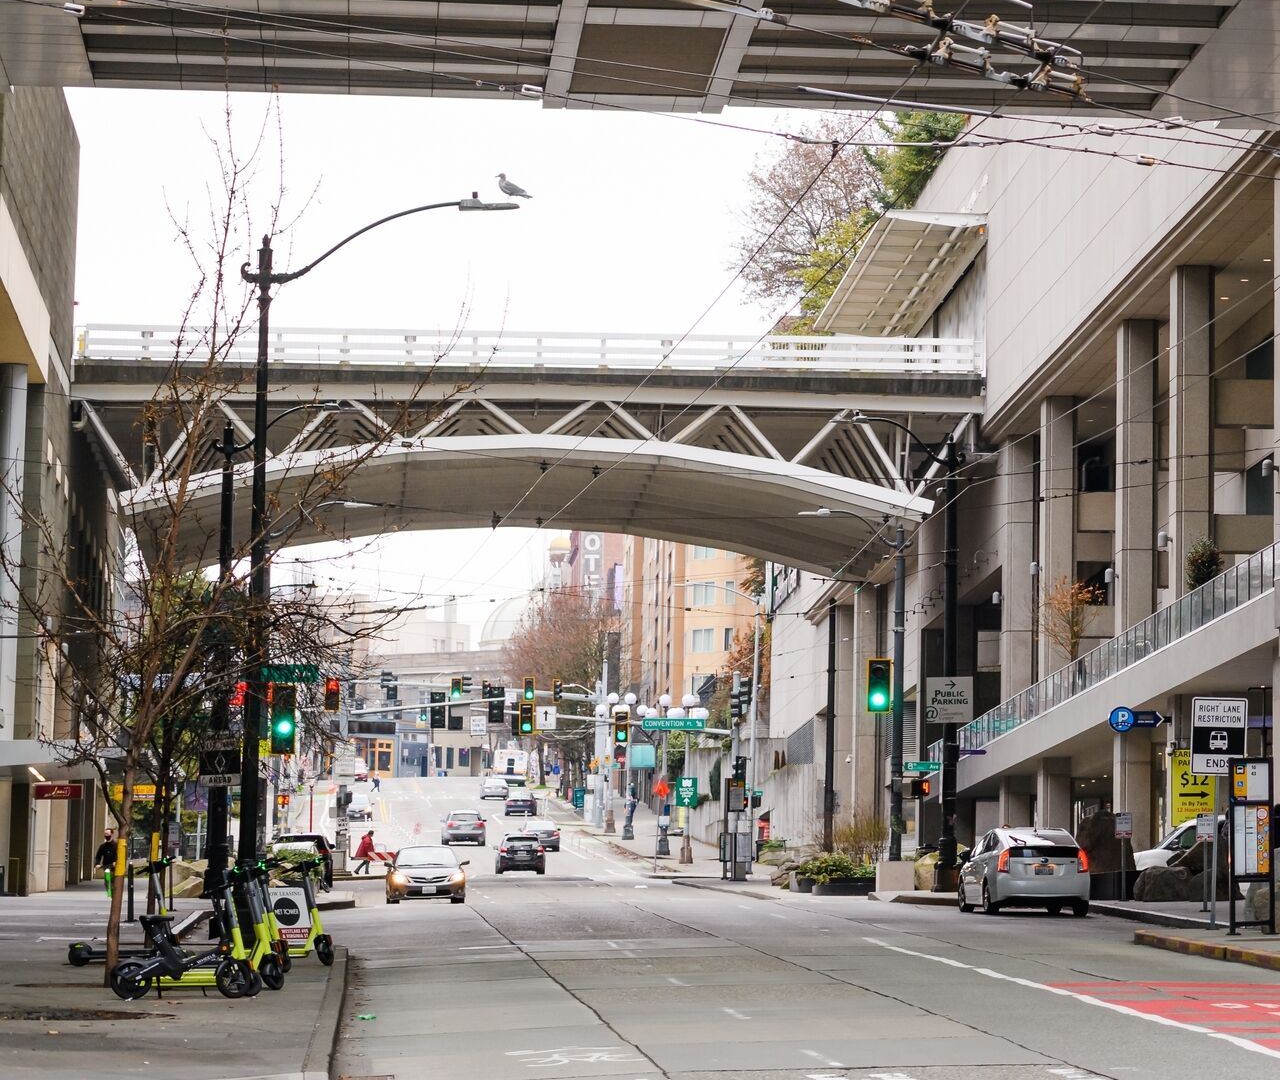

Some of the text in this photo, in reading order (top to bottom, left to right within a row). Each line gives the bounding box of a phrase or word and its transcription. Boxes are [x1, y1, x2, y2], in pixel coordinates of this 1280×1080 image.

[934, 689, 965, 698] PUBLIC
[931, 697, 969, 706] PARKING
[1198, 704, 1241, 713] RIGHT LANE
[1197, 714, 1242, 724] RESTRICTION
